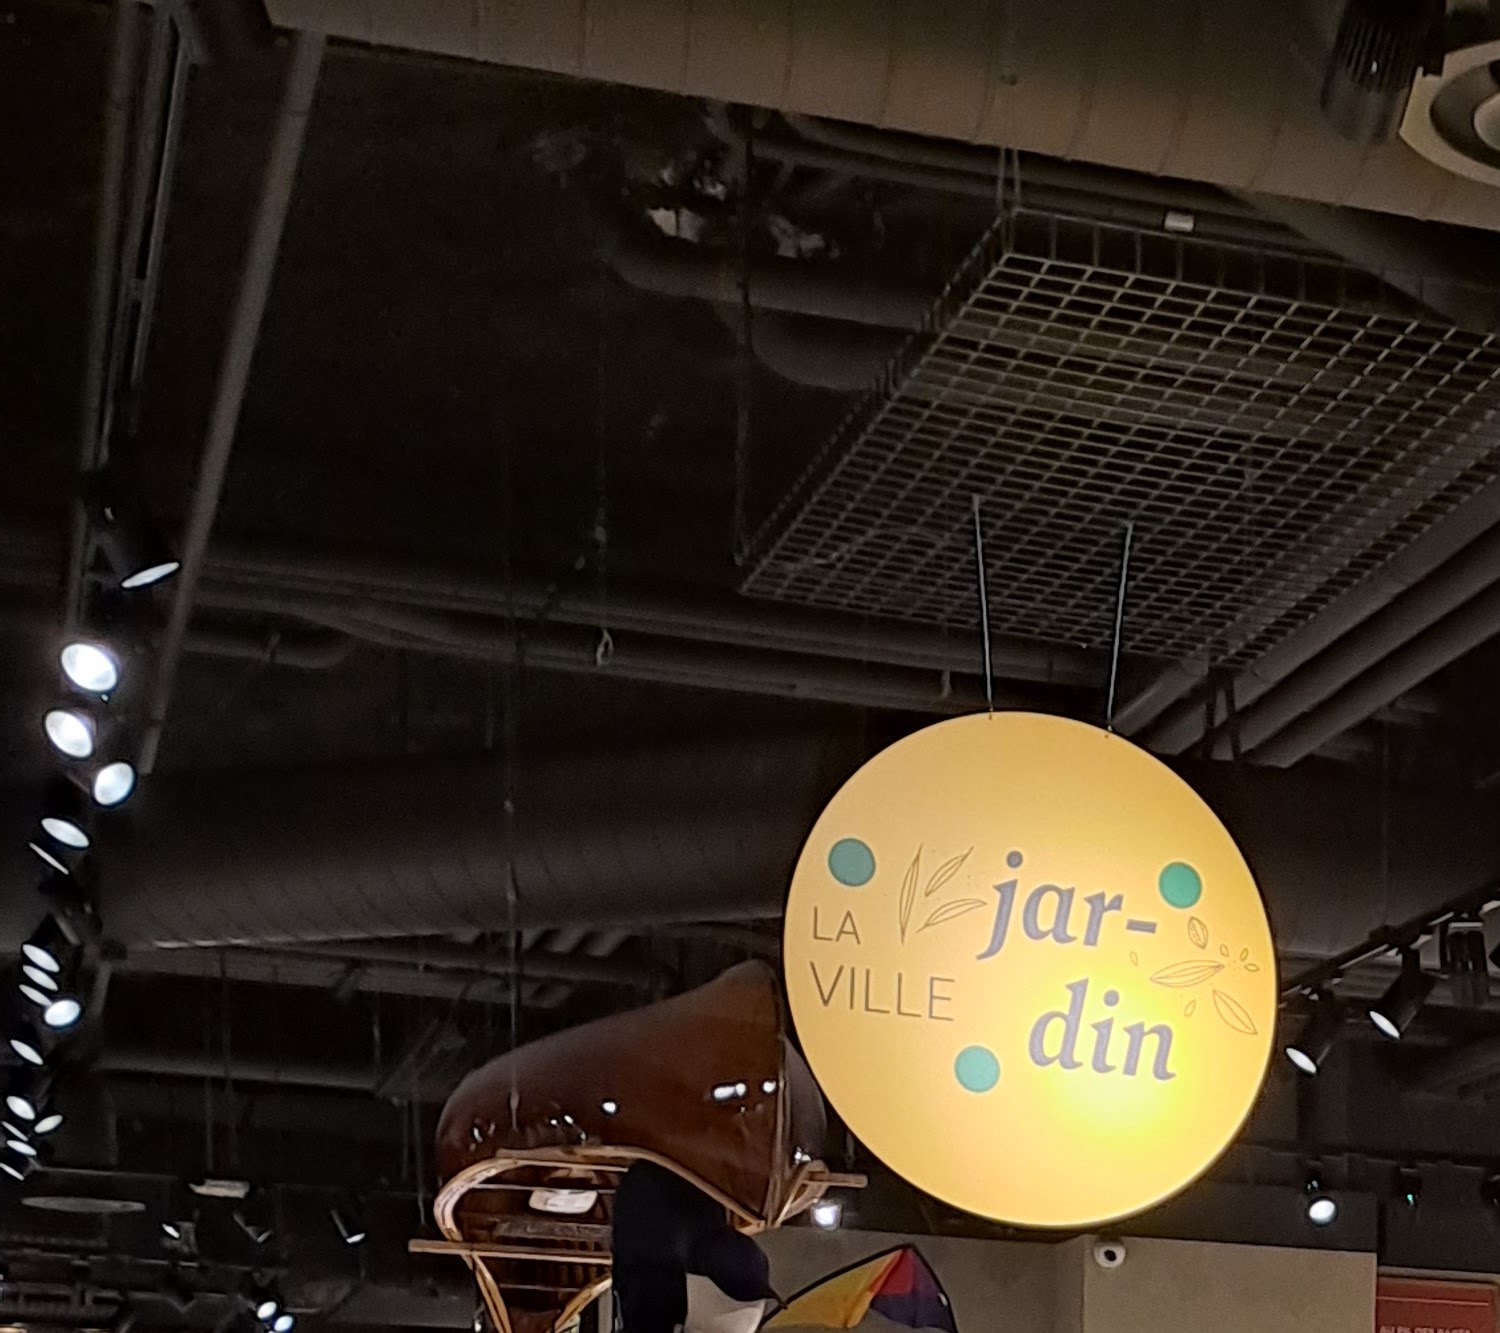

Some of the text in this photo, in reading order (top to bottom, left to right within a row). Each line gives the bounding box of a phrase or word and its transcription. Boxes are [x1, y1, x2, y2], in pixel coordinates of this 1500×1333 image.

[812, 906, 861, 945] LA
[976, 850, 1157, 960] jar-
[809, 961, 956, 1022] VILLE
[1028, 978, 1177, 1081] din
